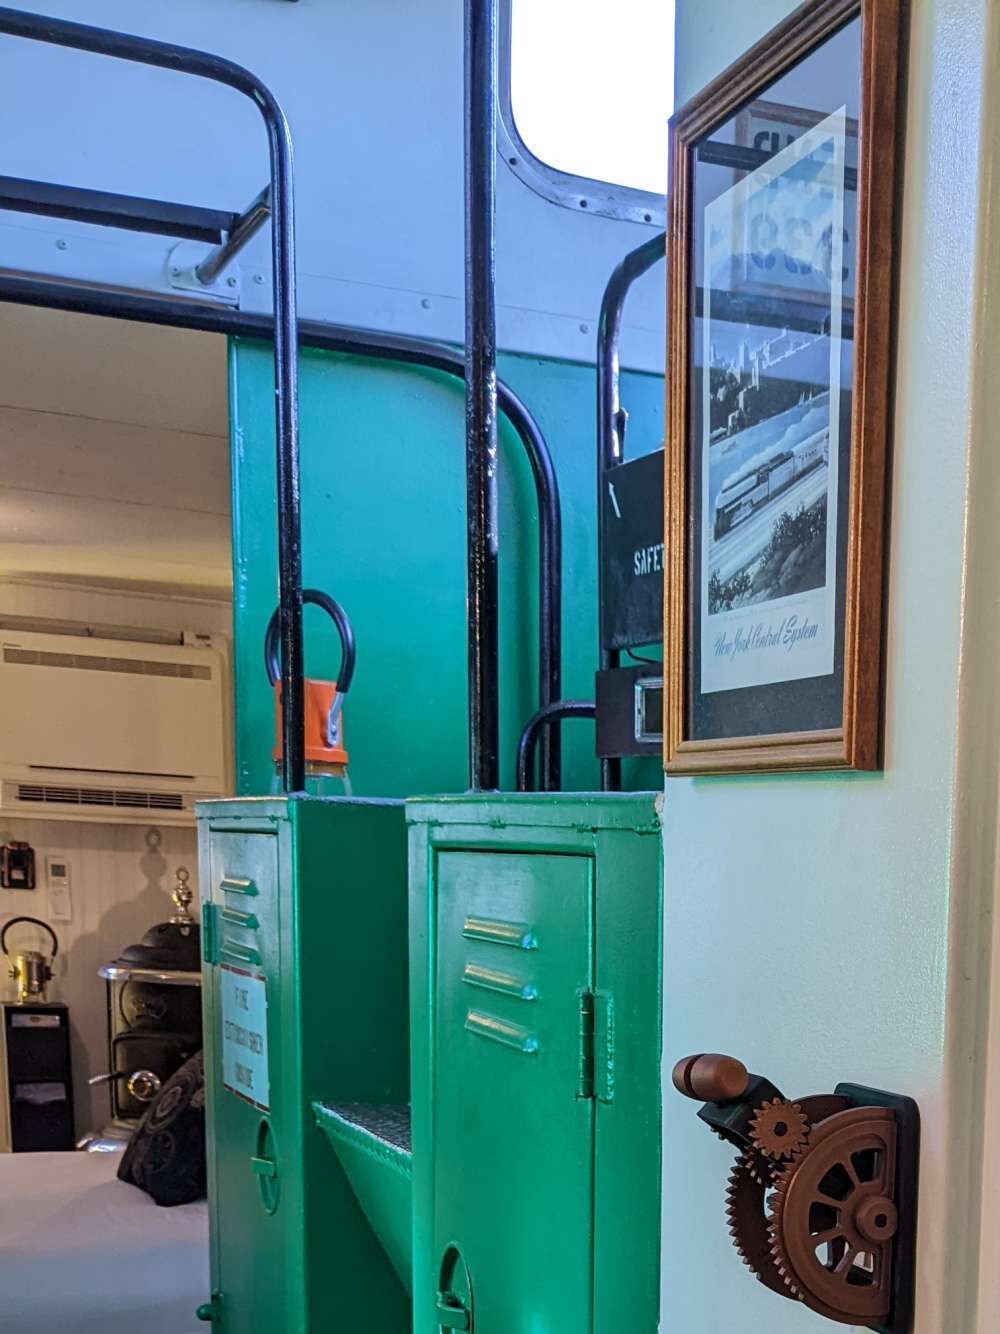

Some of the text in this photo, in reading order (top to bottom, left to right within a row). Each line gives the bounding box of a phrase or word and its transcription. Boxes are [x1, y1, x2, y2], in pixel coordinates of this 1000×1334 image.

[729, 624, 754, 662] York
[752, 619, 785, 649] Central
[783, 615, 819, 654] System
